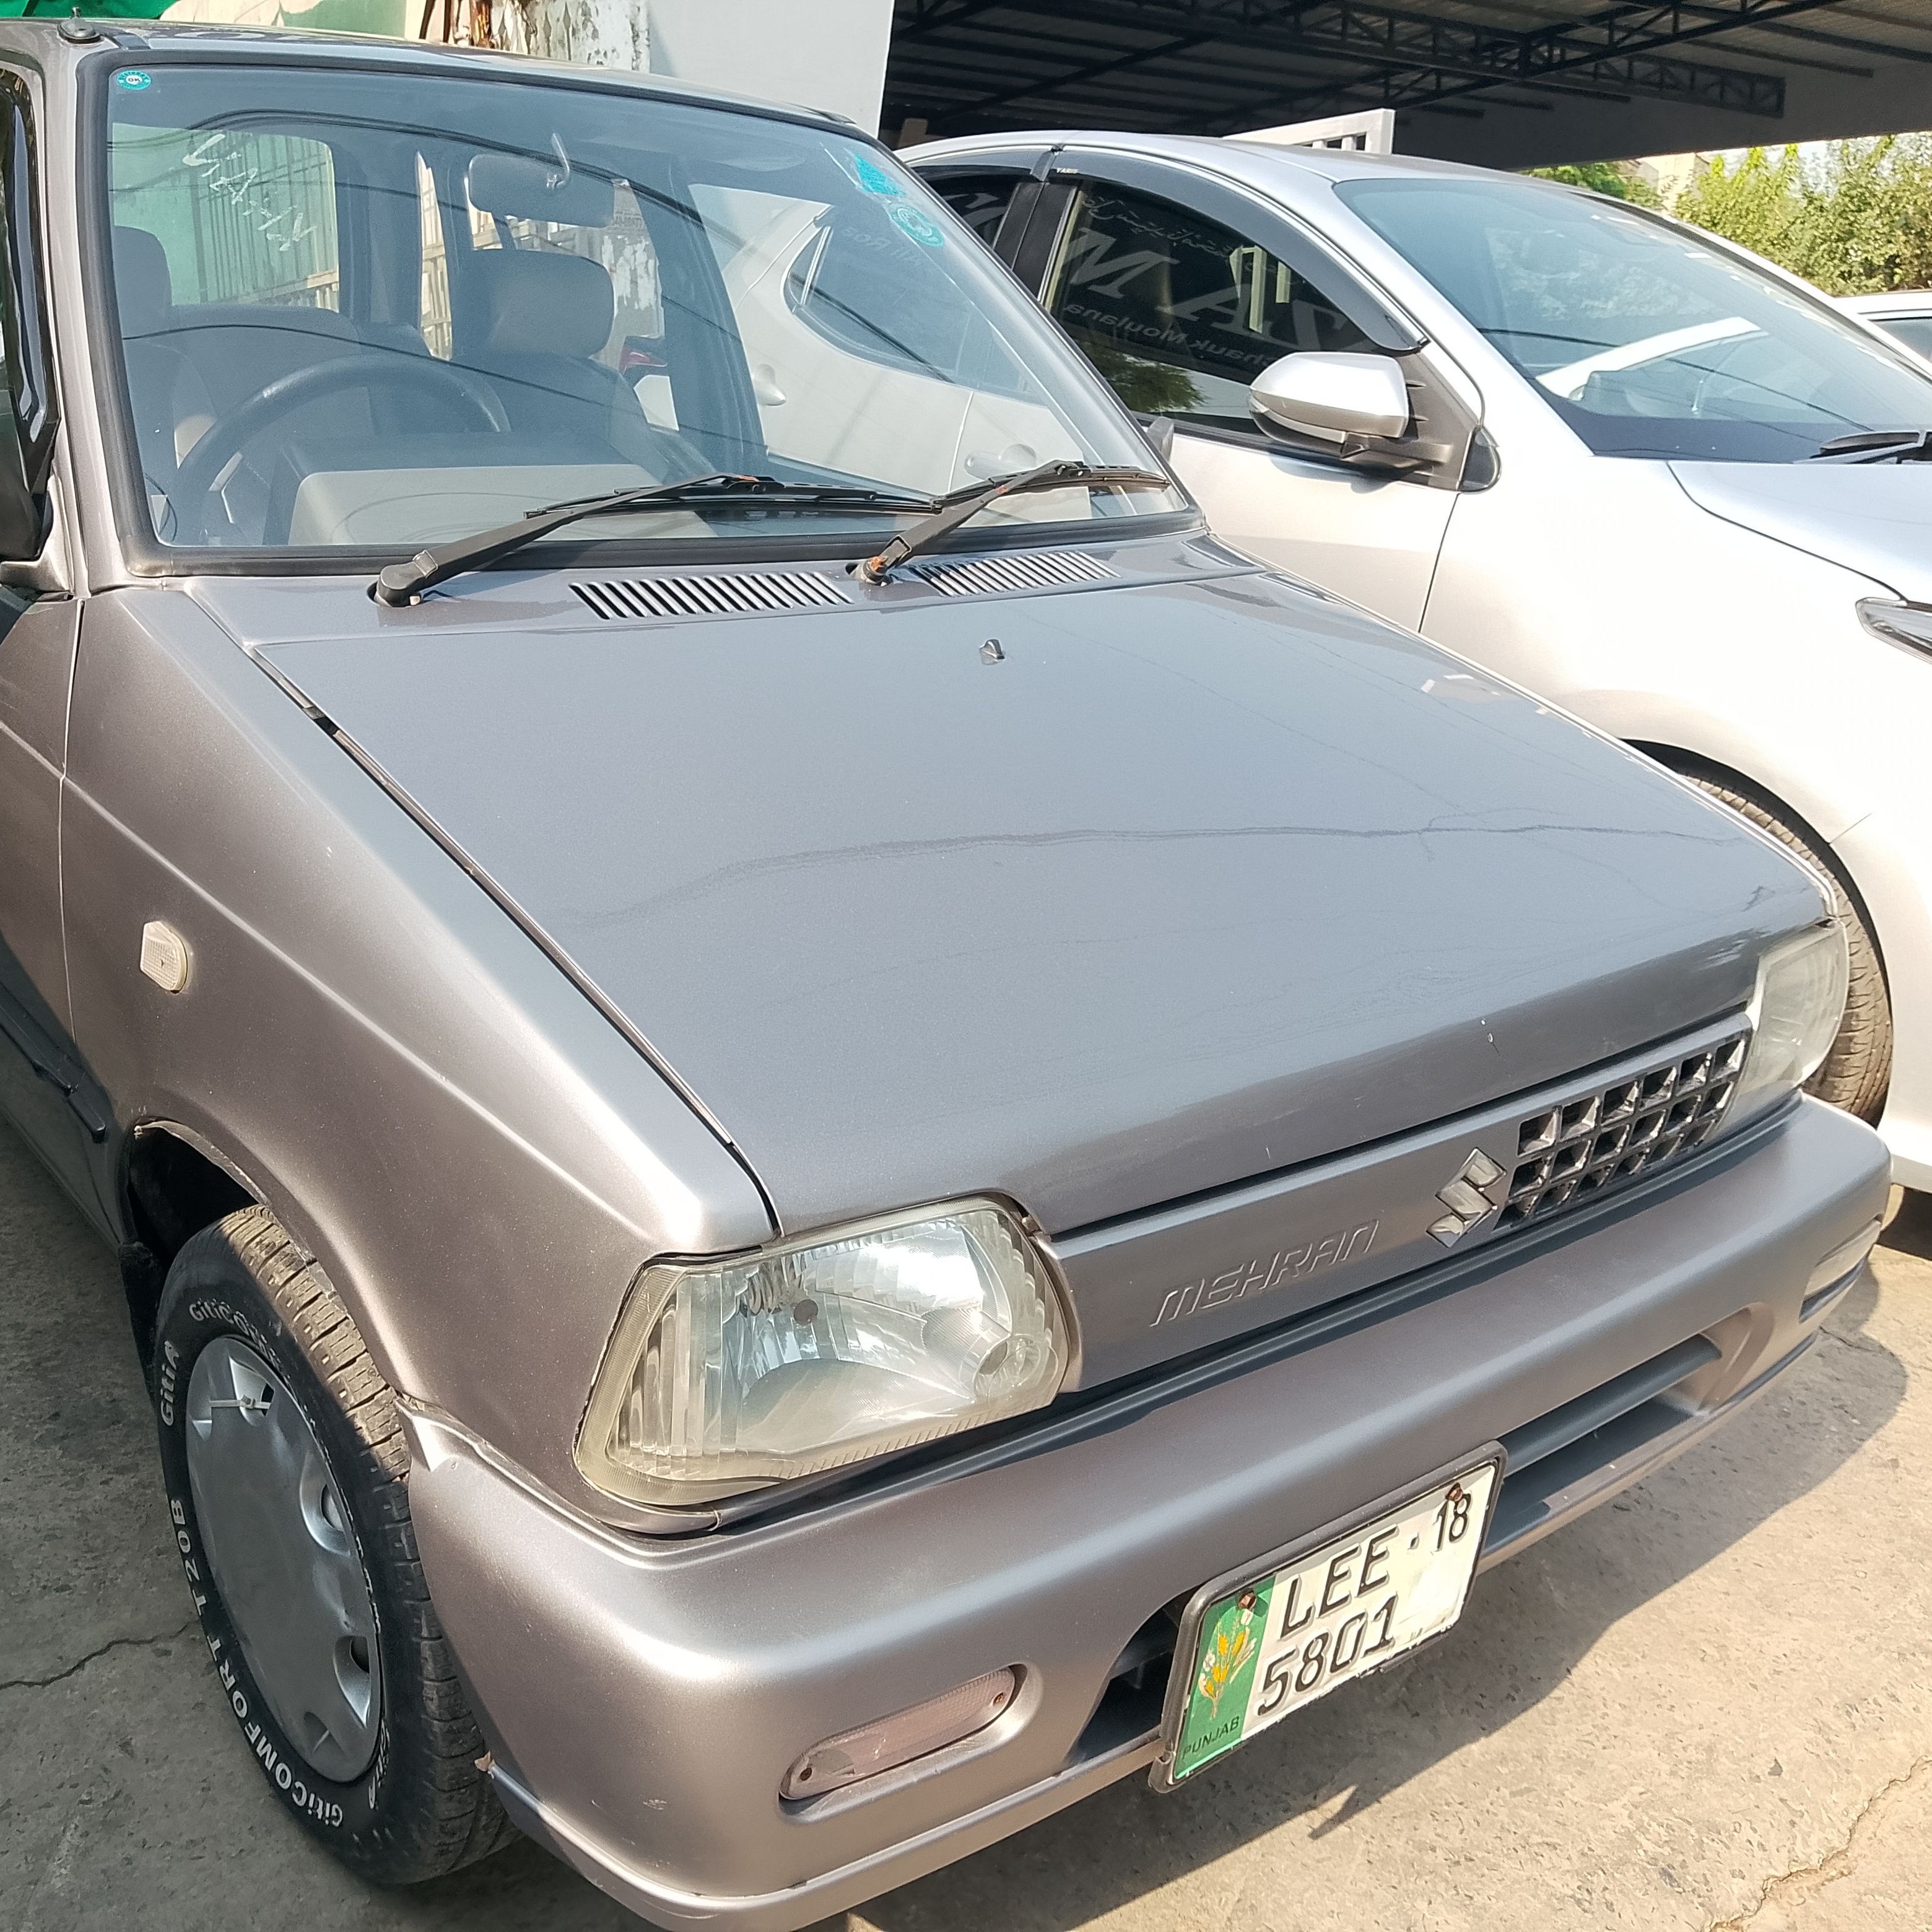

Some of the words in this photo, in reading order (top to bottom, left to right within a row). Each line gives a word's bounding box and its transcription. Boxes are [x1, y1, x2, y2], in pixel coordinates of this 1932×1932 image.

[1149, 1219, 1380, 1327] MEHRAN
[1280, 1523, 1398, 1640] LEE
[1434, 1491, 1472, 1552] 18
[1257, 1592, 1398, 1716] 5801
[1182, 1716, 1239, 1759] PUNJAB
